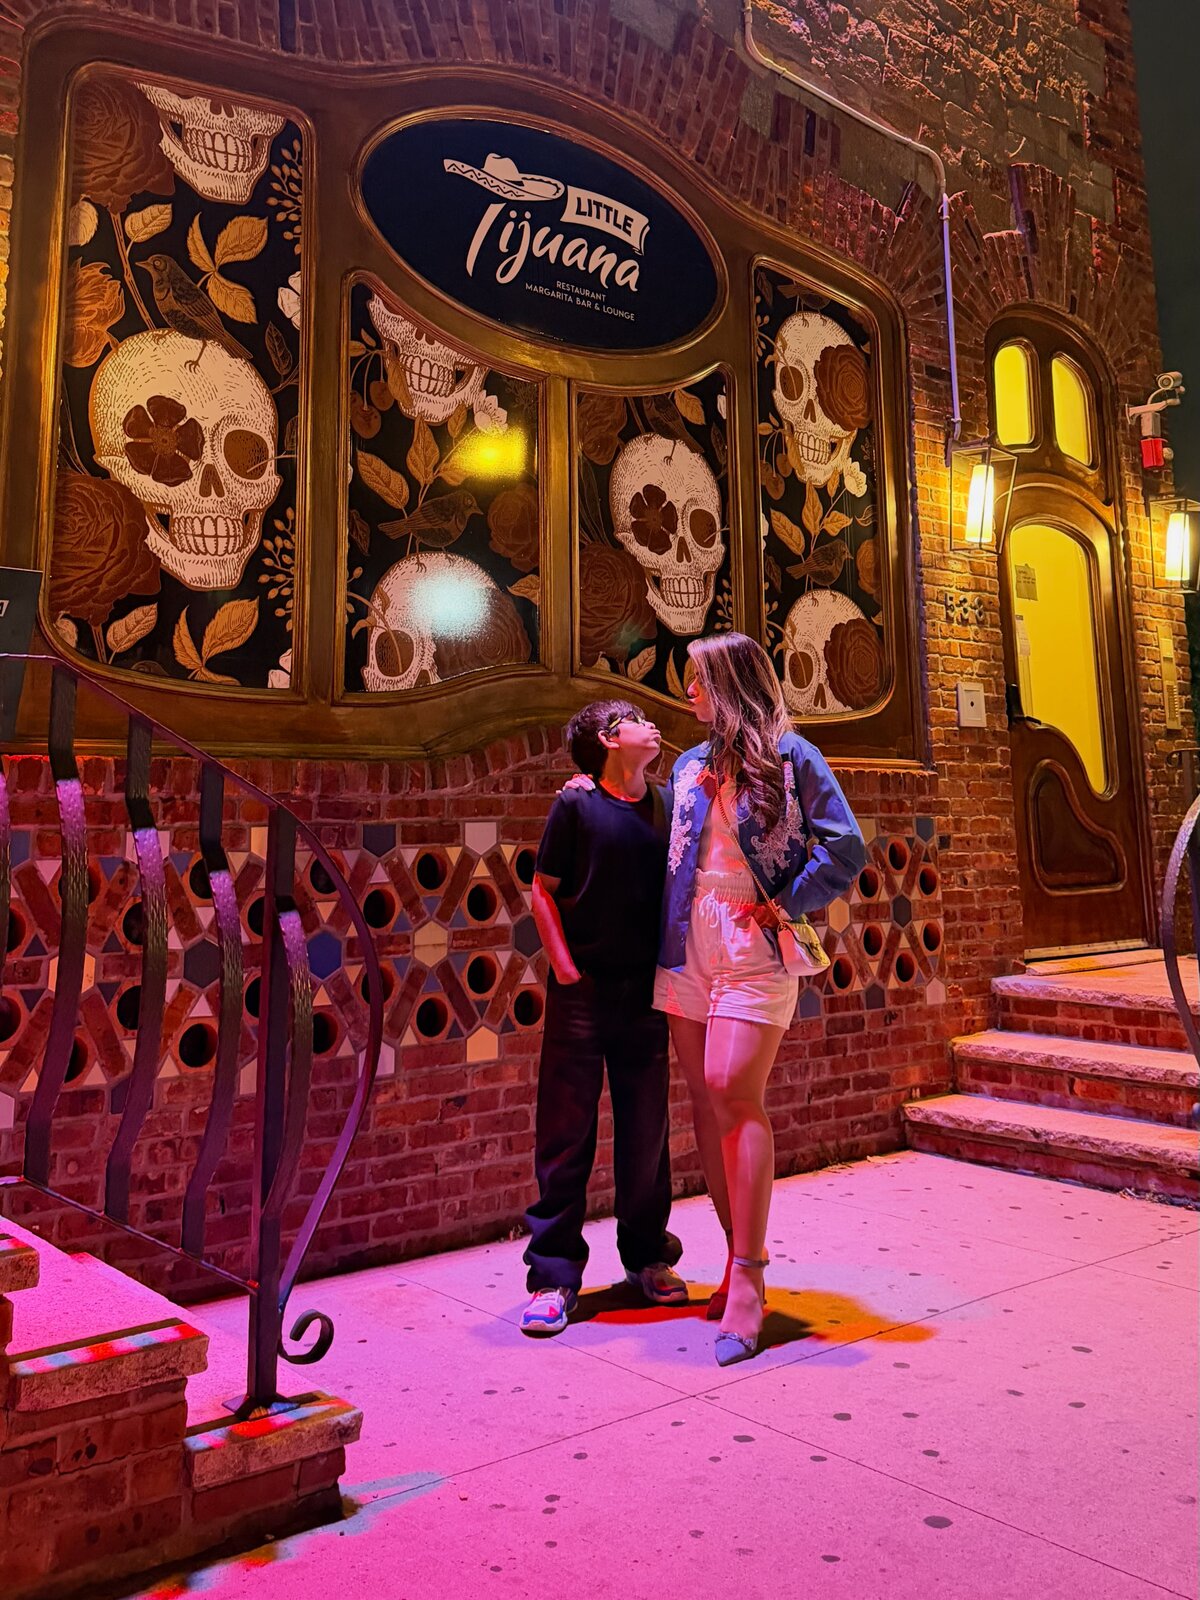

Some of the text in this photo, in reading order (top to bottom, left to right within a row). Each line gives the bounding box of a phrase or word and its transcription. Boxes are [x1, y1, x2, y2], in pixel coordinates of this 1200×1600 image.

[575, 196, 635, 237] LITTLE
[465, 202, 640, 292] Tijuana
[525, 282, 635, 322] MARGARITA BAR & LOUNGE
[556, 280, 607, 302] RESTAURANT
